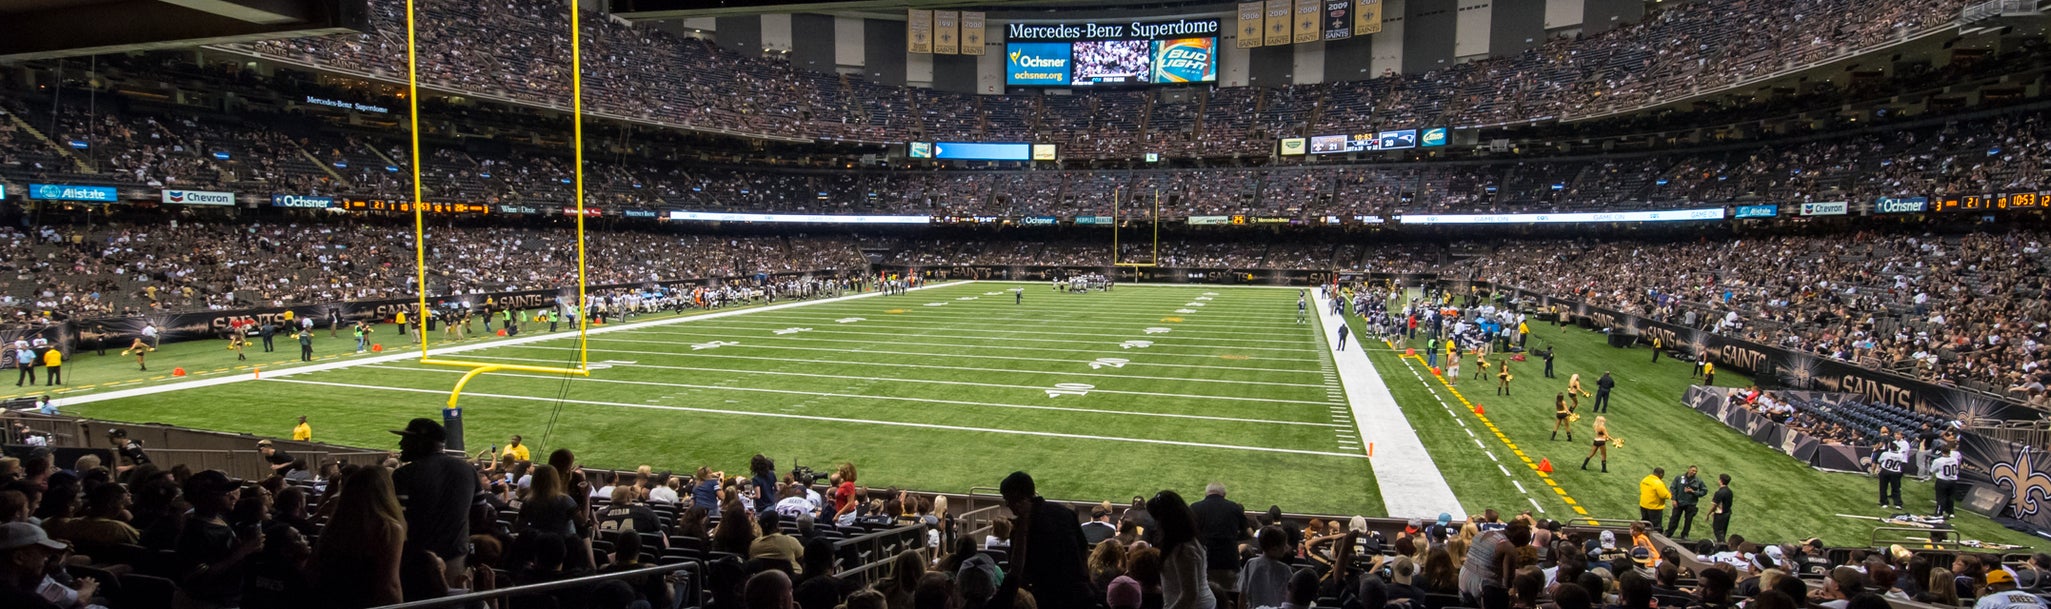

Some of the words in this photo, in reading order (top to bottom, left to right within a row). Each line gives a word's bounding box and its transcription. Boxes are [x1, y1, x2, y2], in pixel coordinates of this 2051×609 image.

[1299, 6, 1317, 14] 2009
[1328, 2, 1348, 11] 2009
[1269, 9, 1288, 17] 2009
[1921, 14, 1949, 29] SAINTS
[1009, 23, 1123, 39] Mercedes-Benz
[1130, 19, 1218, 40] Superdome
[1325, 30, 1349, 39] SAINTS
[1168, 49, 1208, 61] BUD
[1020, 55, 1065, 67] Ochsner
[1161, 57, 1209, 71] LIGHT
[1014, 71, 1063, 81] ochsner.org
[306, 95, 352, 109] Mercedes-Benz
[354, 102, 388, 113] Superdome
[1384, 139, 1394, 147] 20
[62, 188, 105, 200] Allstate
[187, 192, 229, 203] Chevron
[2013, 193, 2035, 206] 10:53
[284, 194, 329, 208] Ochsner
[374, 201, 384, 209] 21
[1884, 199, 1923, 212] Ochsner
[1936, 201, 1942, 211] 3
[1967, 197, 1979, 208] 21
[1986, 199, 1990, 208] 1
[1998, 197, 2007, 208] 10
[2041, 195, 2051, 207] 12
[501, 205, 517, 213] Winn
[1750, 207, 1771, 216] Allstate
[1815, 203, 1843, 213] Chevron
[1025, 216, 1053, 224] Ochsner
[1234, 216, 1243, 224] 25
[500, 294, 542, 309] SAINTS
[1593, 312, 1615, 330] SAINTS
[1647, 326, 1676, 348] SAINTS
[1843, 375, 1911, 410] SAINTS
[1885, 459, 1901, 470] 00
[1943, 464, 1957, 477] 00
[2008, 594, 2039, 604] BREES
